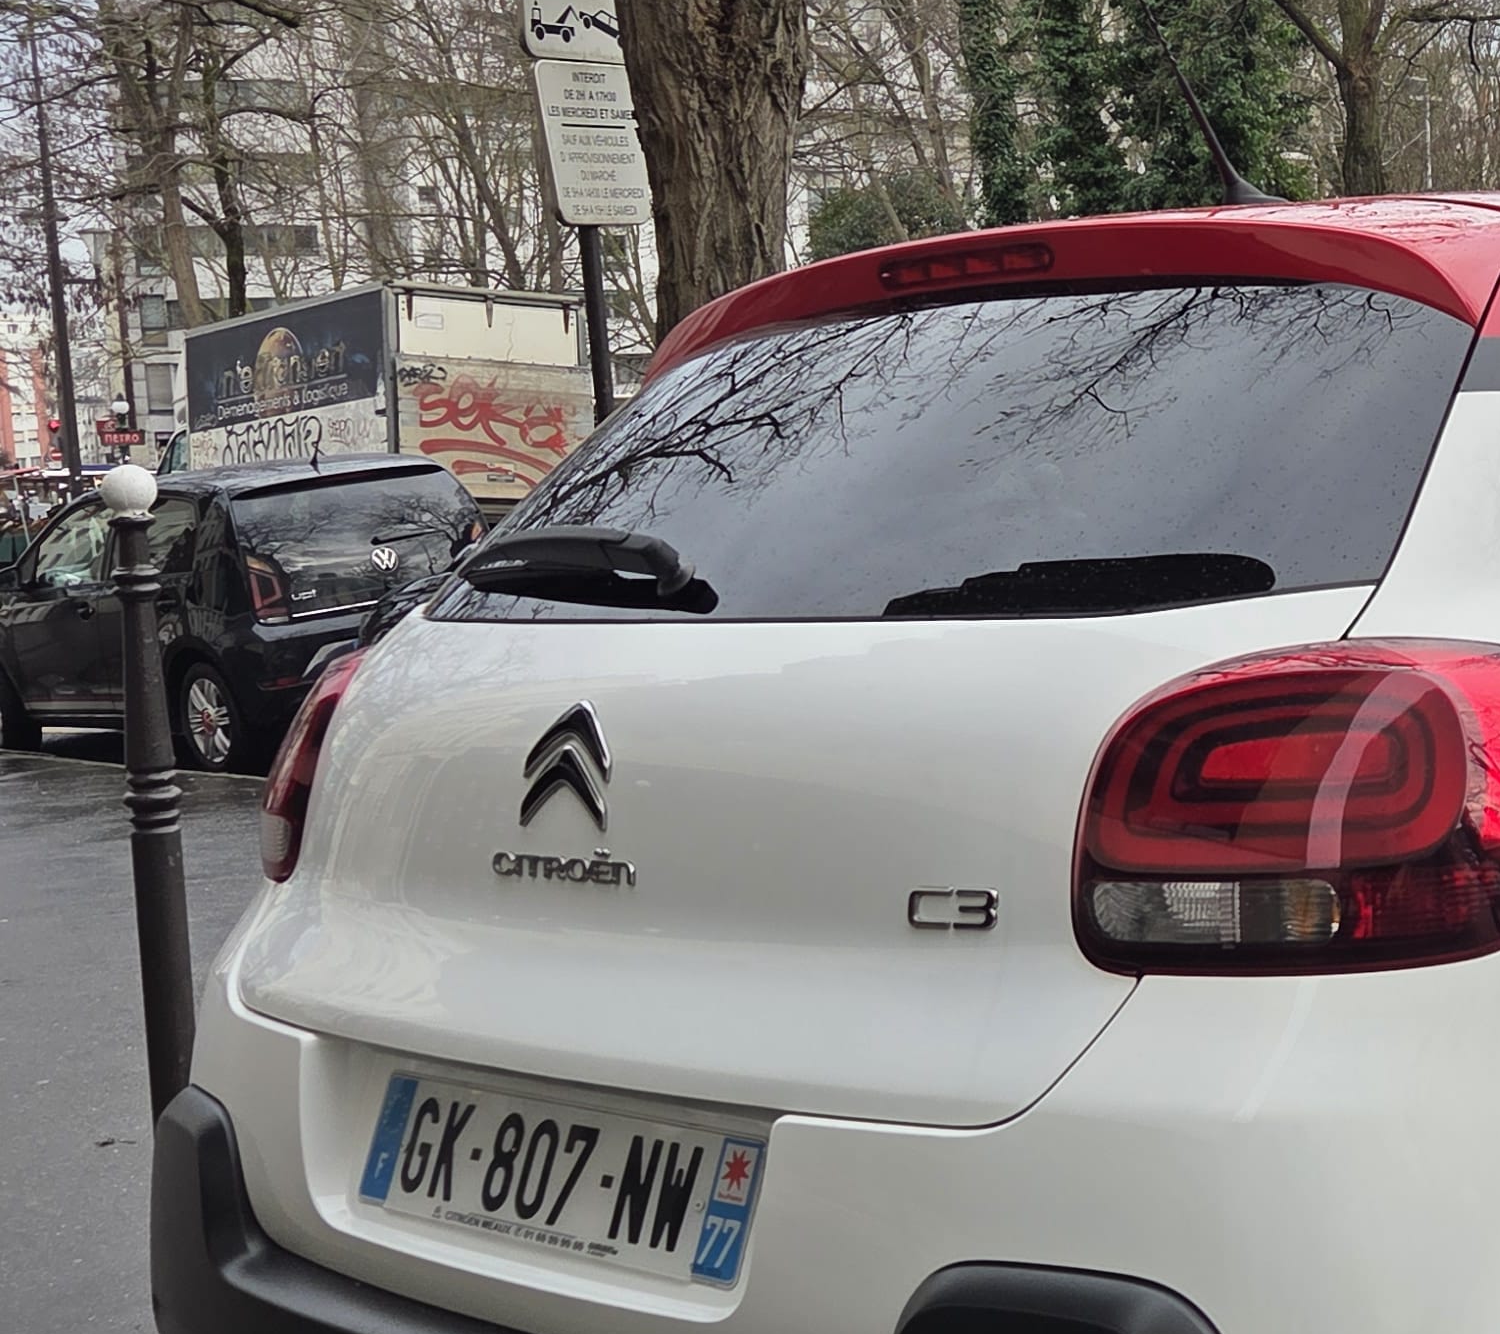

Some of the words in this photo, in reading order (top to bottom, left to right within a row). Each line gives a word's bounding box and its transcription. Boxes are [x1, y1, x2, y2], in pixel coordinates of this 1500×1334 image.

[572, 71, 606, 83] INTERDIT
[563, 88, 575, 100] DE
[548, 105, 560, 117] LES
[561, 107, 598, 119] MERCREDI
[599, 108, 609, 119] ET
[561, 133, 577, 145] SAUF
[907, 885, 999, 931] C3
[373, 1152, 389, 1179] F
[400, 1097, 705, 1253] GK-807-NW
[697, 1215, 742, 1269] 77
